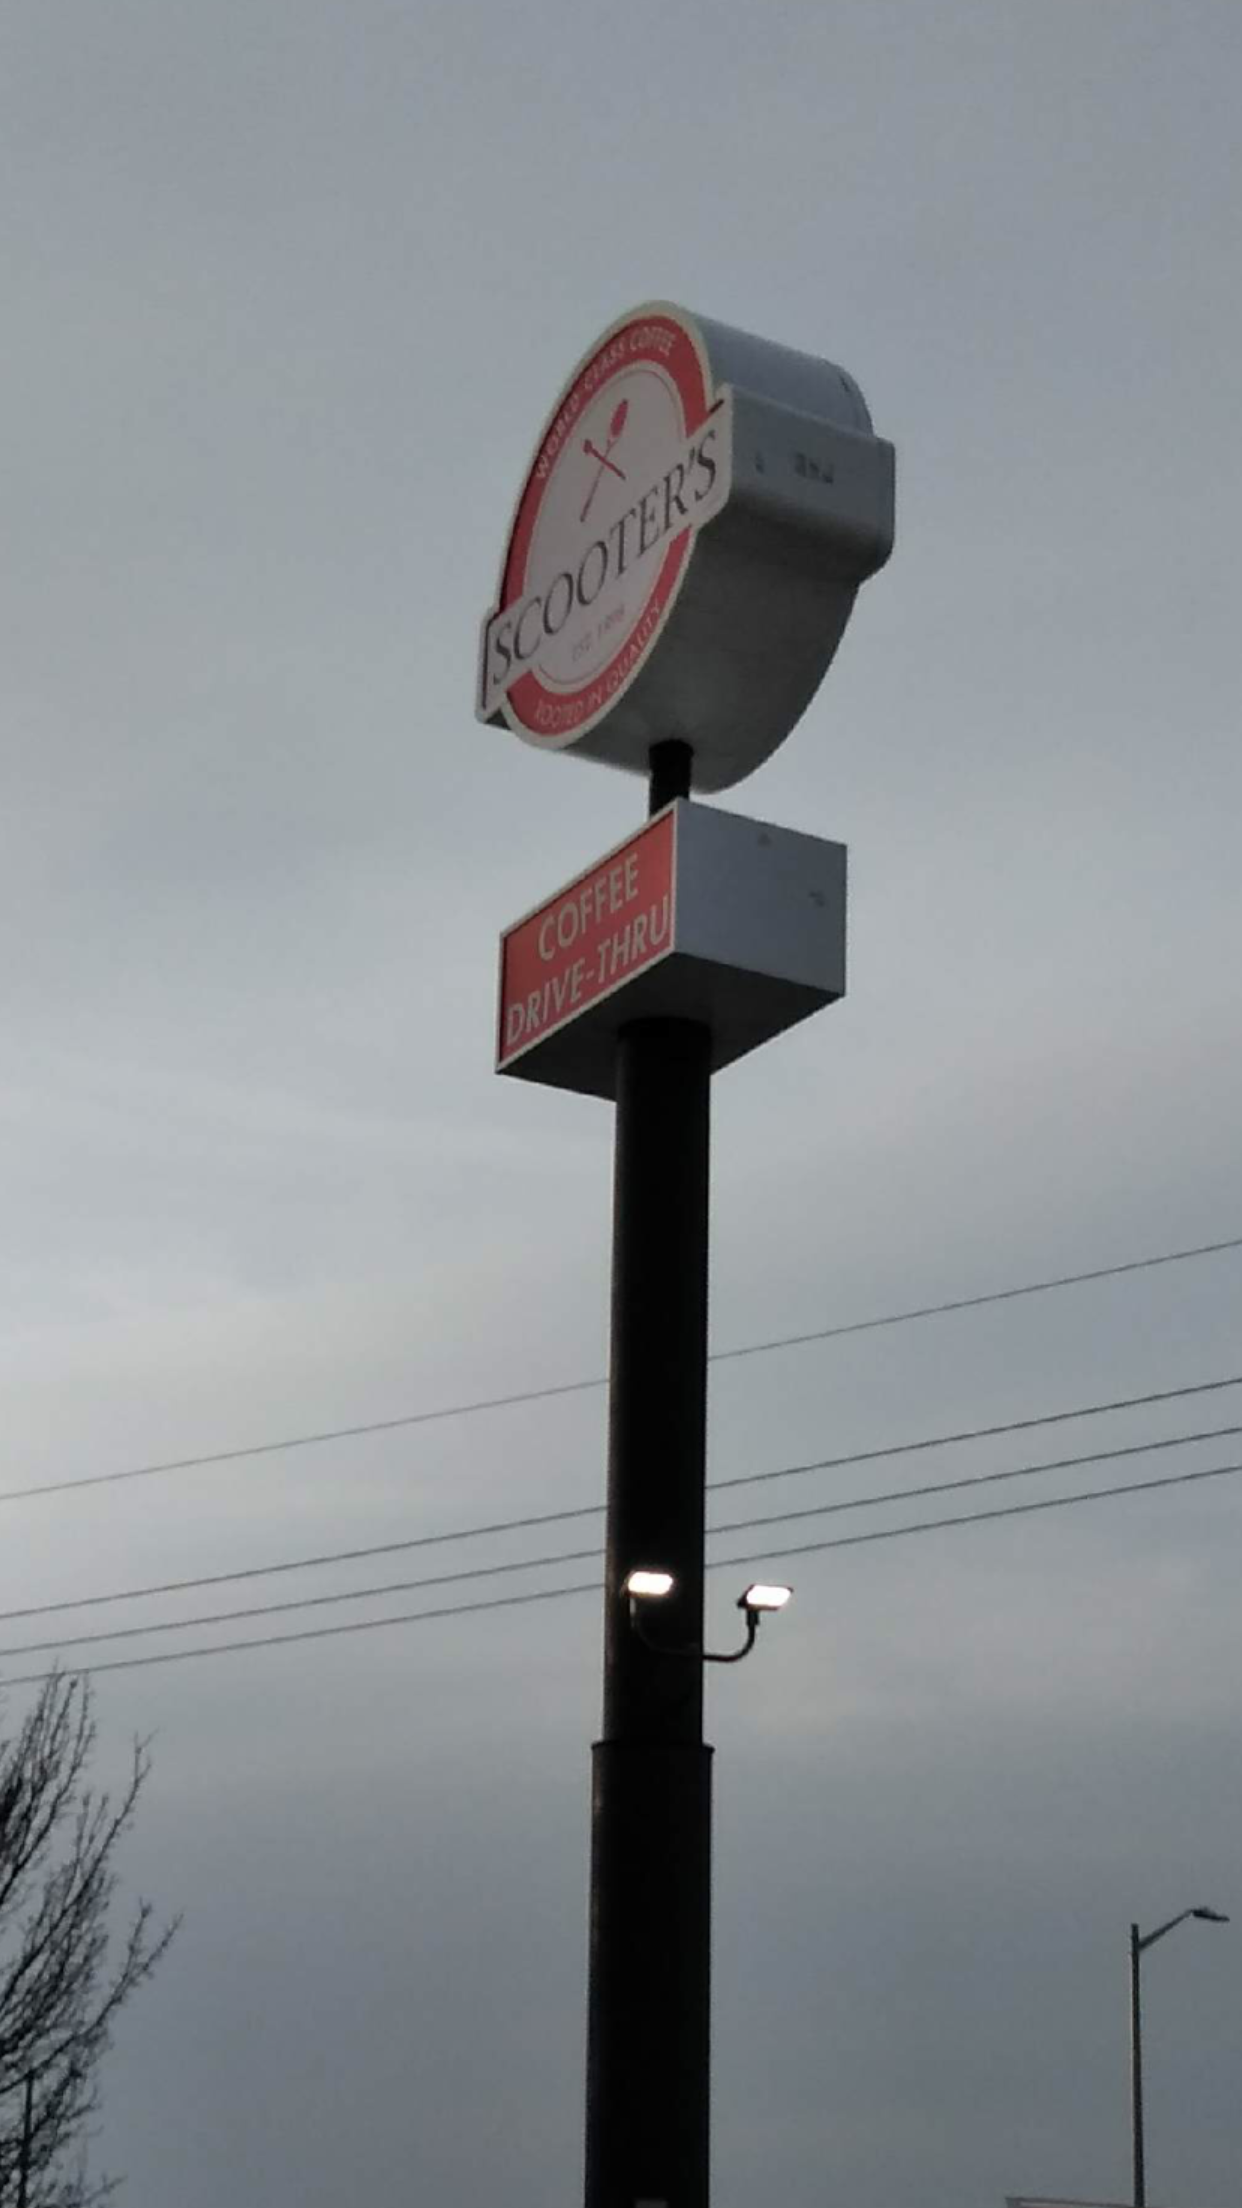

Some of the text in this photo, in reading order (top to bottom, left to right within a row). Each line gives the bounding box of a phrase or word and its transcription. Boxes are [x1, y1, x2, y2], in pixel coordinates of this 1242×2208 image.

[629, 325, 677, 357] COFFEE
[493, 429, 717, 685] SCOOTER'S
[587, 684, 603, 708] IN
[605, 597, 661, 693] QUALITY
[538, 852, 640, 961] COFFEE
[505, 893, 671, 1047] DRIVE-THRU
